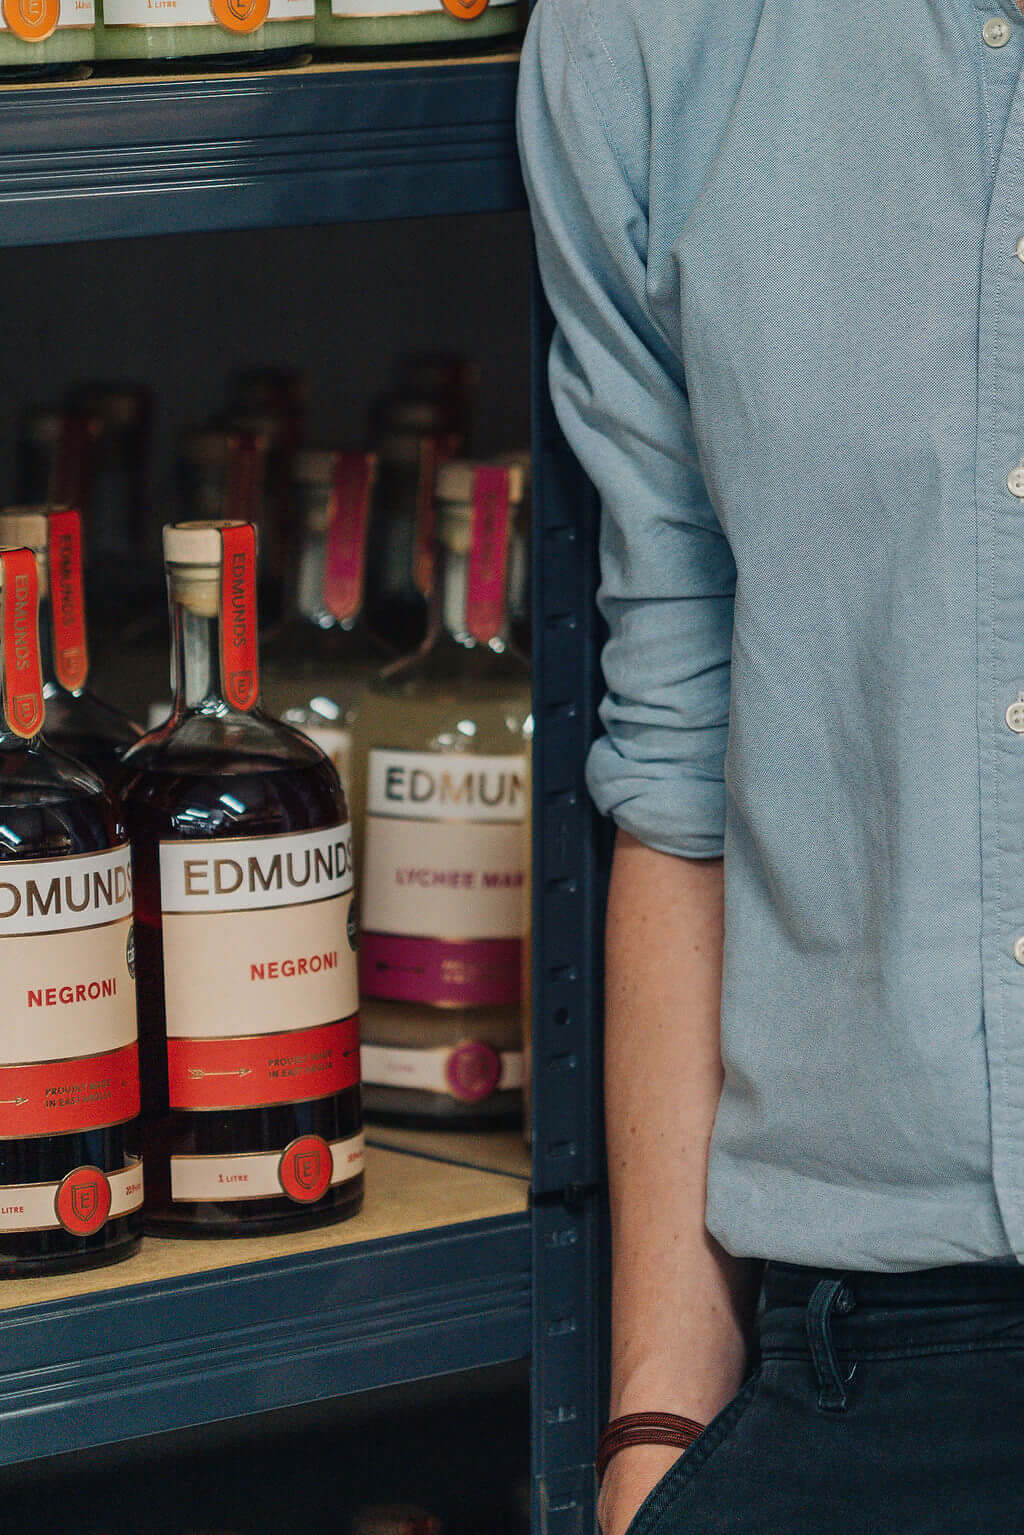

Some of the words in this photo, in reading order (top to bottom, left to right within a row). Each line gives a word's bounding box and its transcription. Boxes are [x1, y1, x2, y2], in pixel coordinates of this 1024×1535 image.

[232, 553, 248, 649] EDMUNDS
[14, 574, 30, 671] EDMUNDS
[250, 951, 338, 981] NEGRONI
[27, 977, 117, 1008] NEGRONI
[1, 1205, 25, 1215] LITRE
